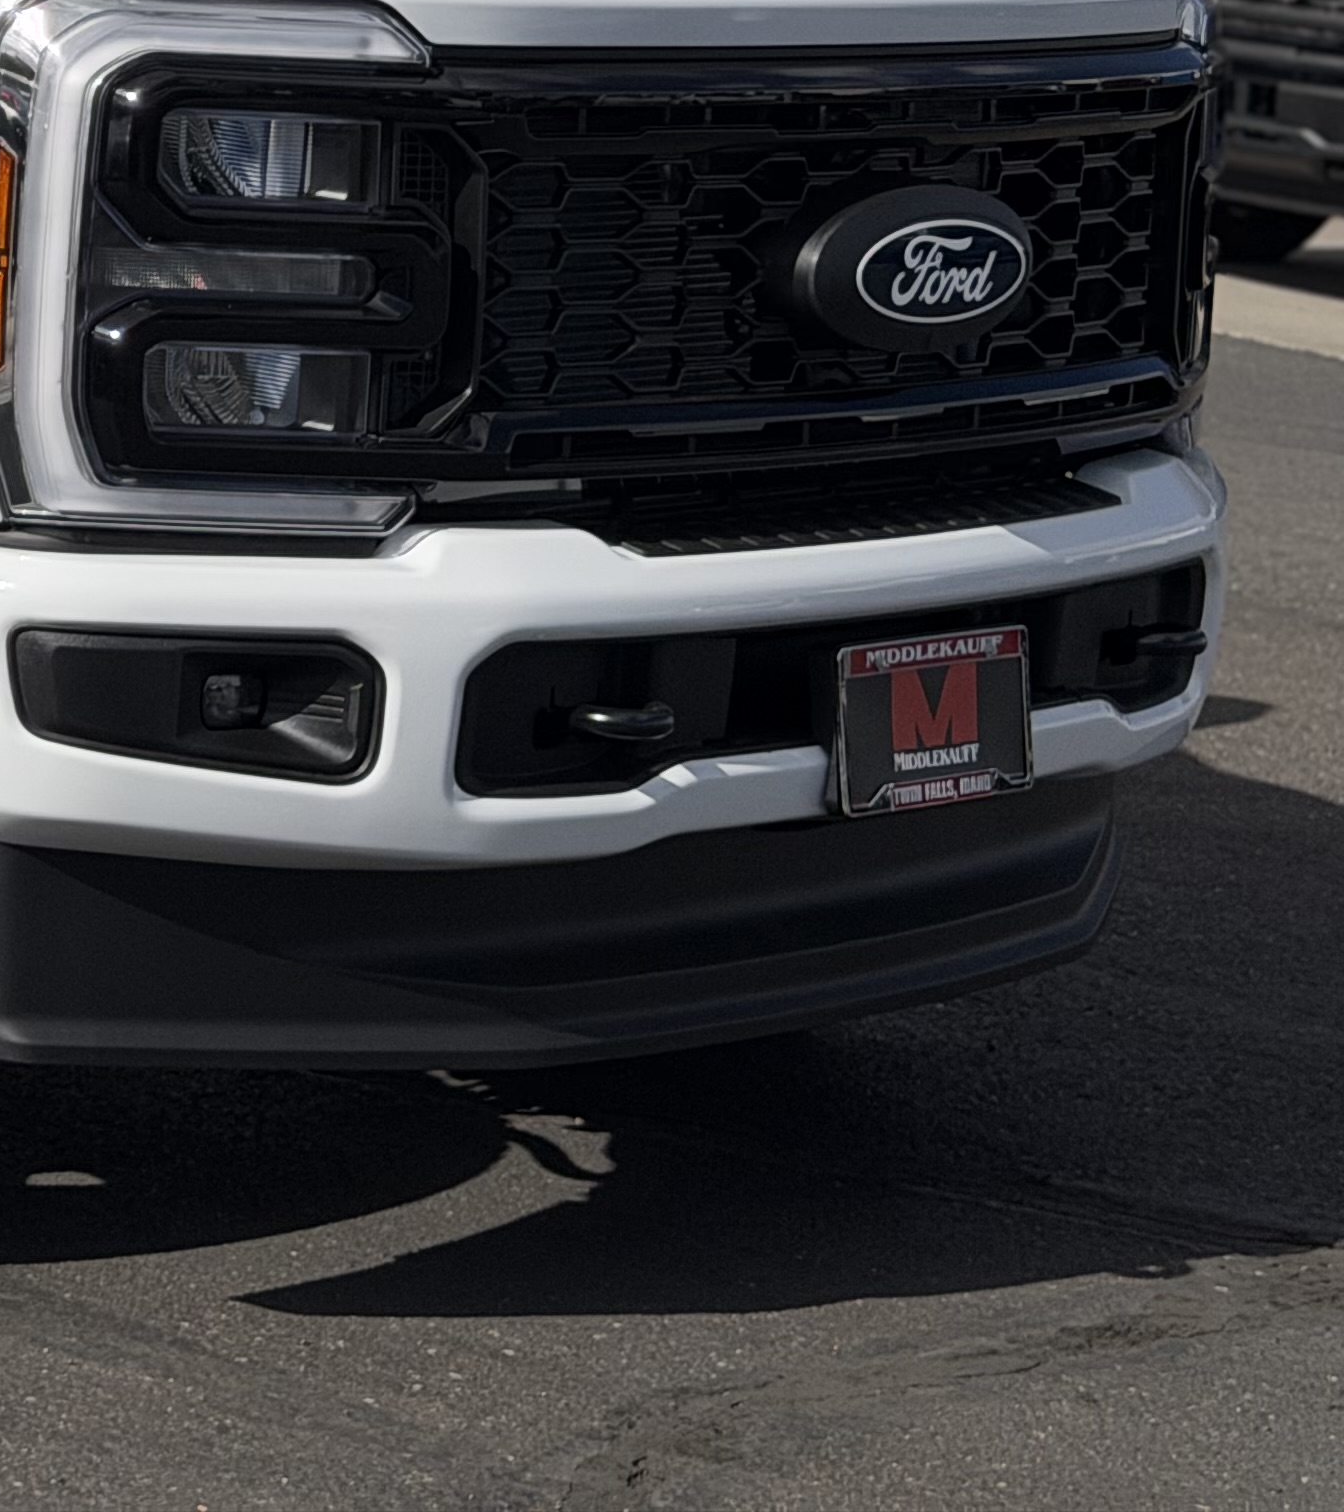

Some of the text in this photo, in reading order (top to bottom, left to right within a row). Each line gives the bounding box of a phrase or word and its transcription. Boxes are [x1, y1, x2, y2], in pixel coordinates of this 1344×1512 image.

[891, 235, 998, 306] Ford
[865, 634, 1004, 669] MIDDLEKAUFF
[890, 662, 979, 752] M
[893, 742, 980, 773] MIDDLEKAUFF
